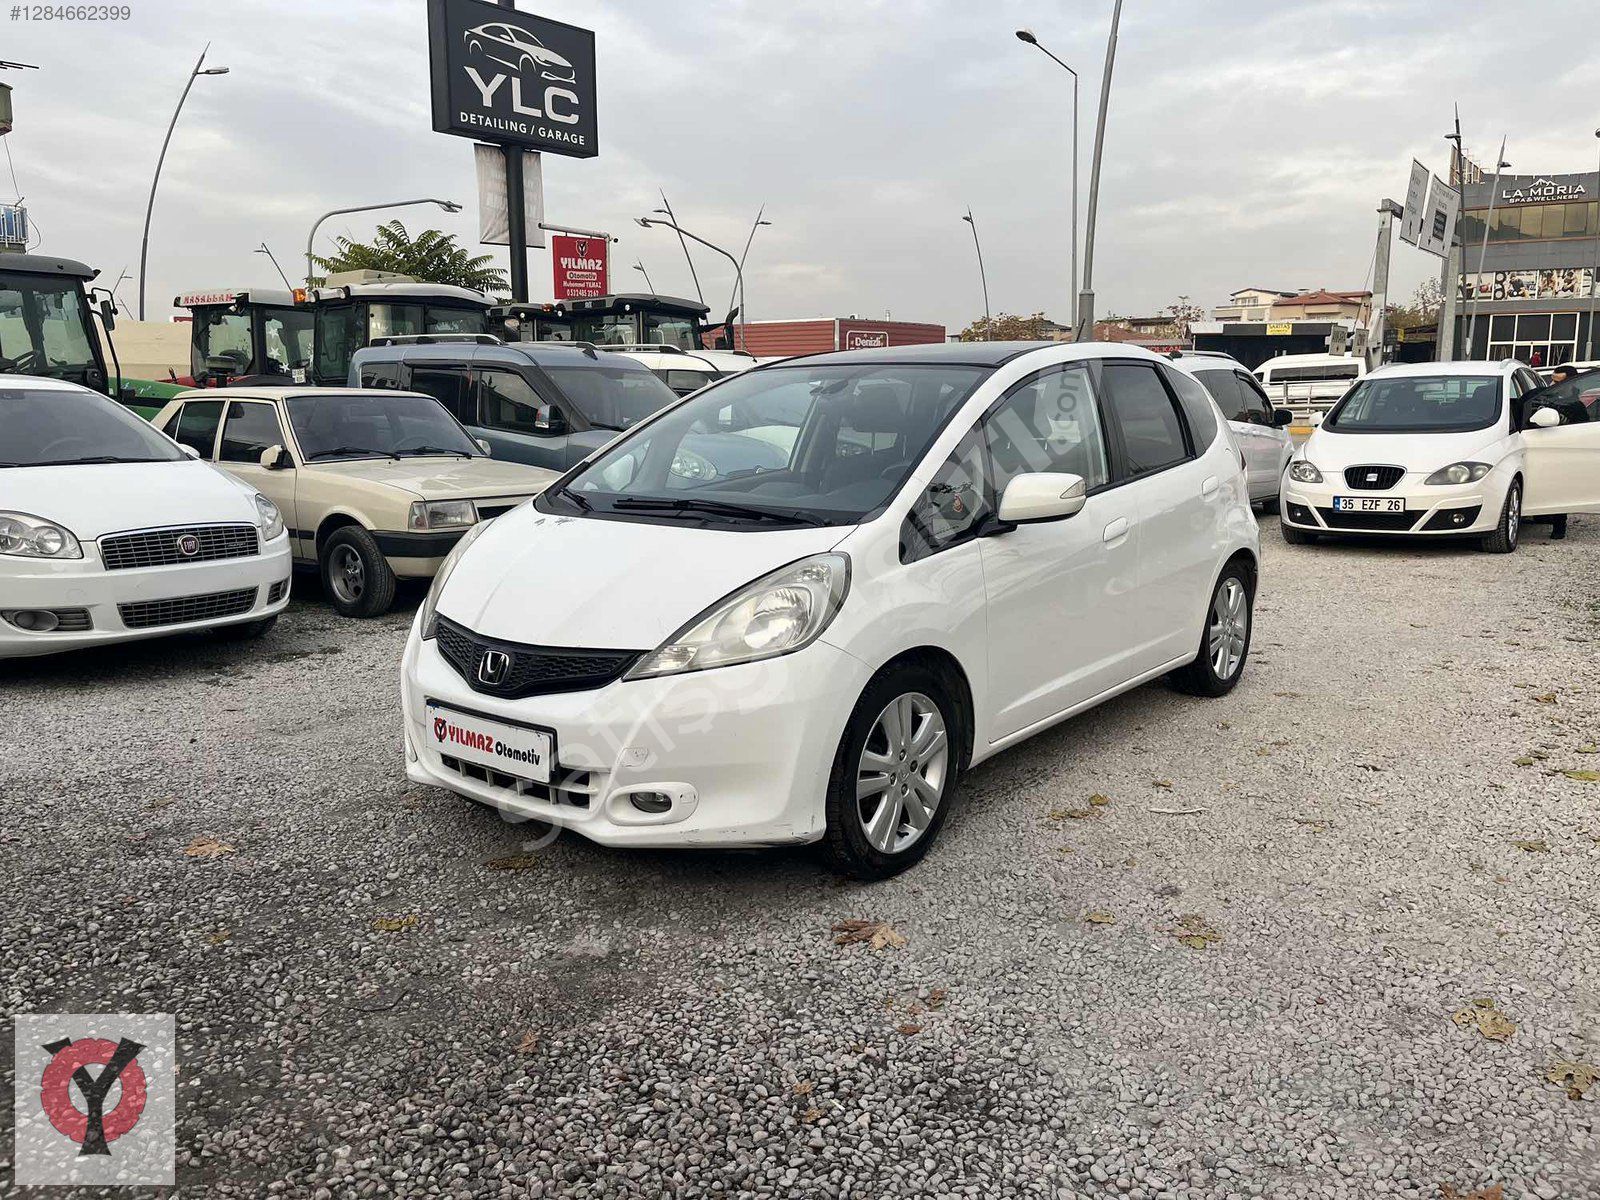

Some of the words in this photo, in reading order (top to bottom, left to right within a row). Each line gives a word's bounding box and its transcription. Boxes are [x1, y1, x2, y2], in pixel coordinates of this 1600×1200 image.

[463, 66, 579, 125] YLC
[460, 111, 527, 134] DETAILING
[538, 126, 585, 146] GARAGE
[1502, 189, 1524, 198] LA
[1529, 184, 1586, 197] MORIA
[560, 257, 603, 270] YILMAZ
[855, 336, 881, 347] Denizli
[1341, 499, 1354, 510] 35
[1361, 499, 1381, 510] EZF
[1387, 499, 1400, 511] 26
[448, 725, 494, 753] YILMAZ
[495, 741, 541, 766] Otomotiv
